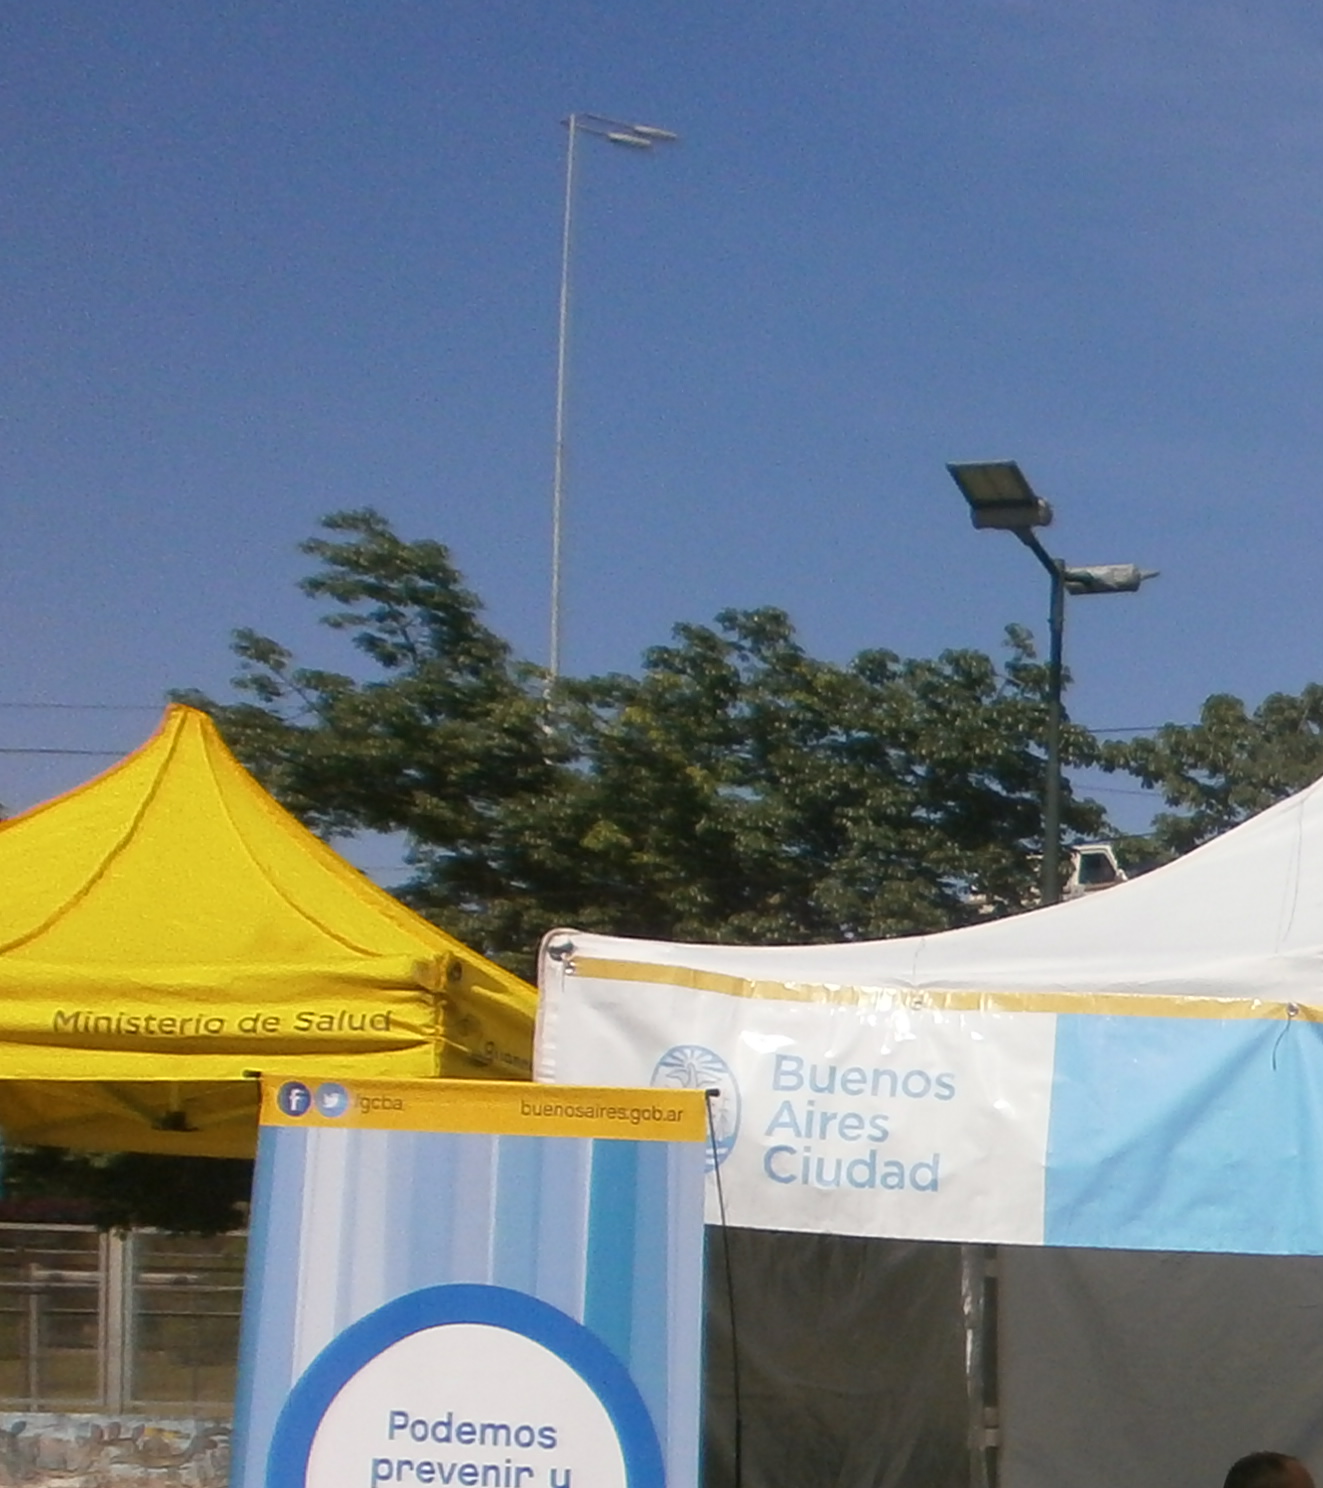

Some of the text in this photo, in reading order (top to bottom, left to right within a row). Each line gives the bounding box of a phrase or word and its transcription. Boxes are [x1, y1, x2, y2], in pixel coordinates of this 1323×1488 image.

[53, 1010, 392, 1035] Ministerio de Salud
[772, 1053, 956, 1100] Buenos
[520, 1100, 684, 1124] buenosaires.gob.ar
[765, 1100, 889, 1143] Aires
[764, 1145, 941, 1192] Ciudad
[388, 1410, 557, 1449] Podemos
